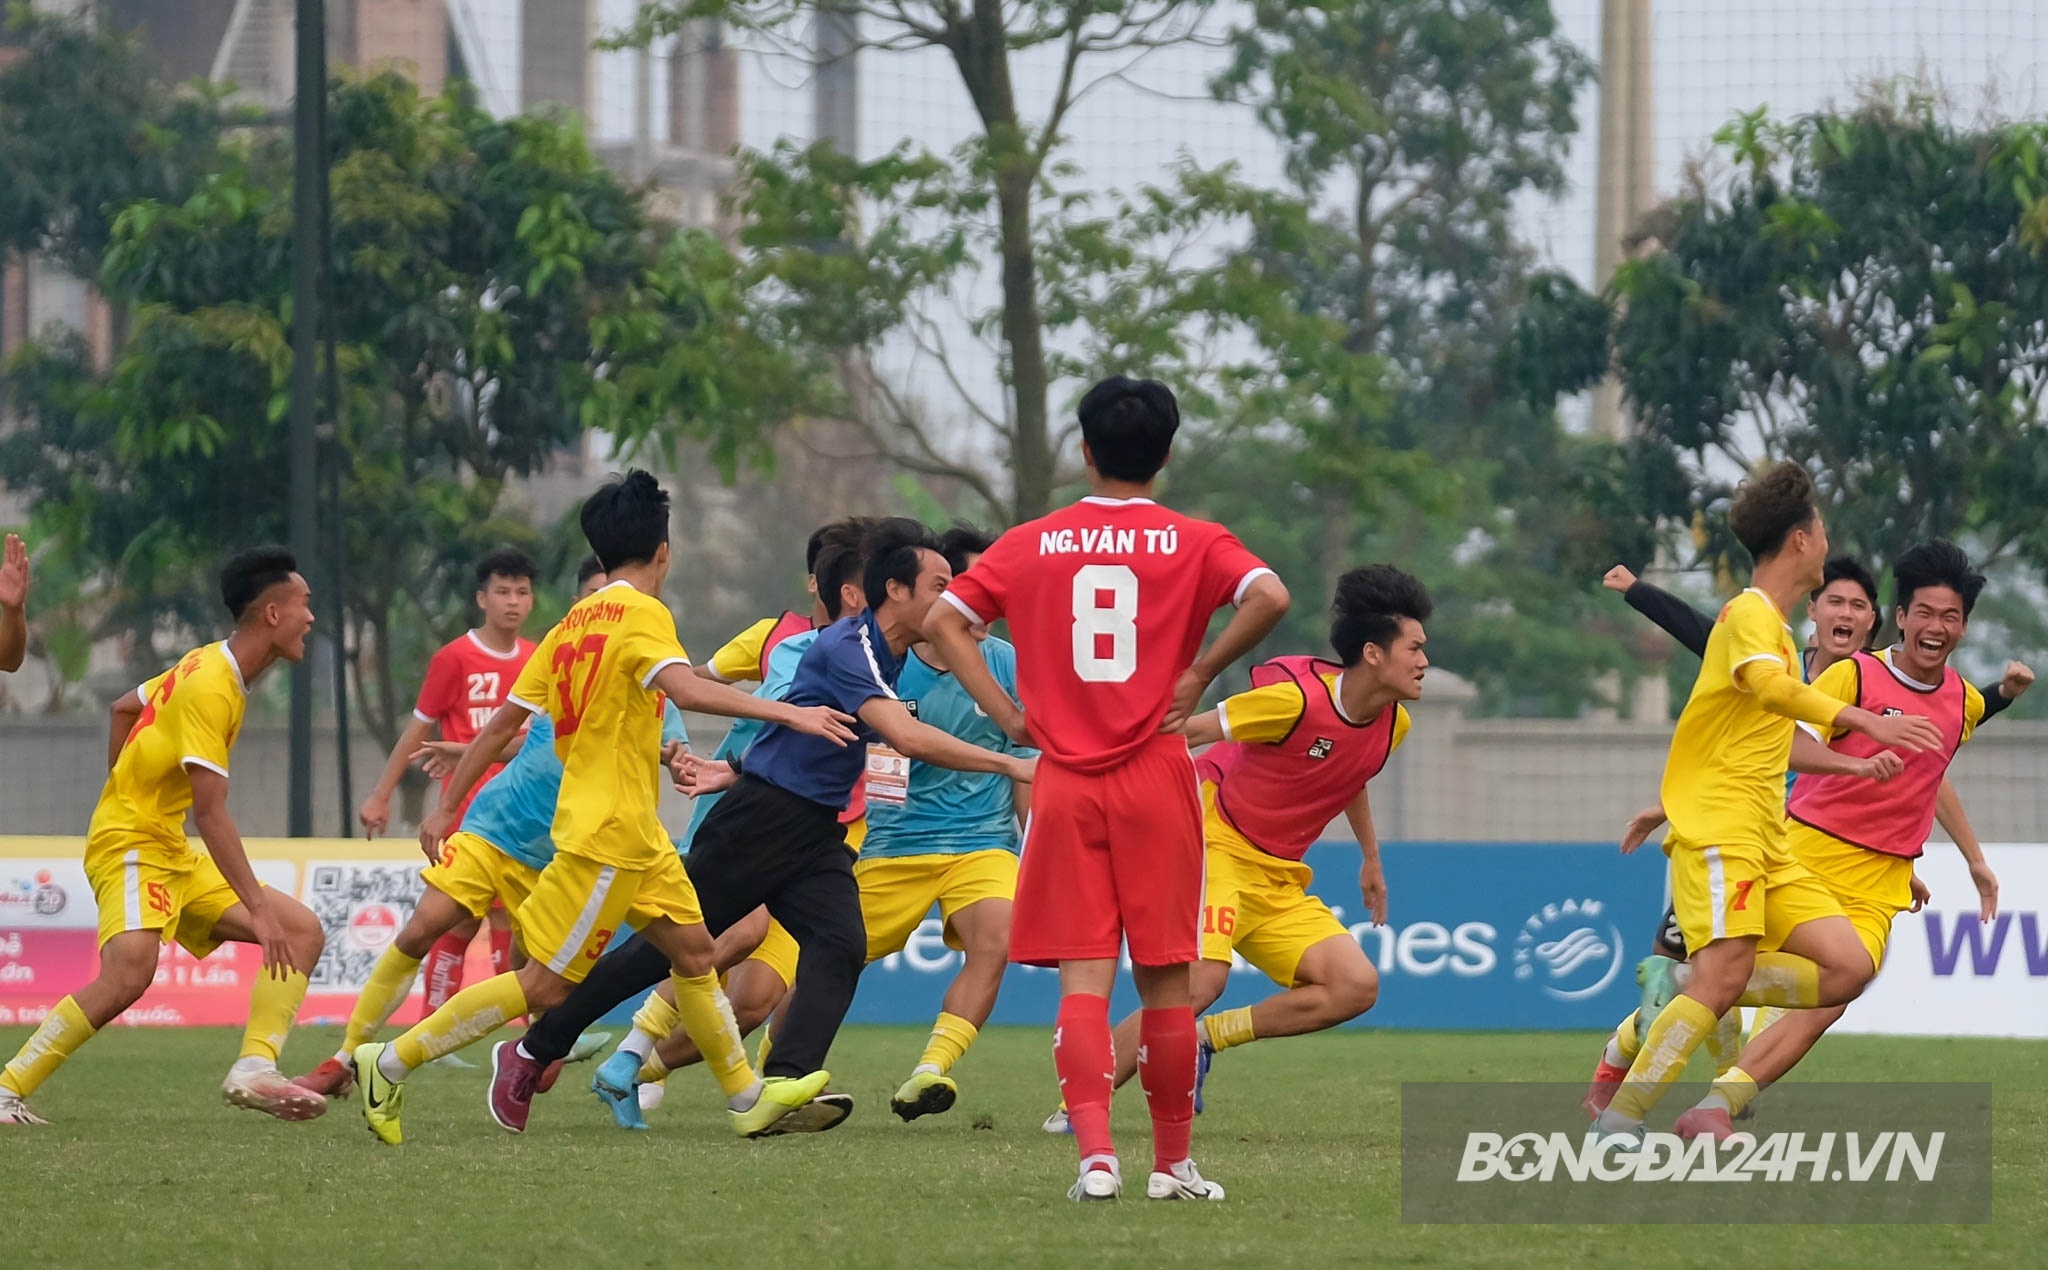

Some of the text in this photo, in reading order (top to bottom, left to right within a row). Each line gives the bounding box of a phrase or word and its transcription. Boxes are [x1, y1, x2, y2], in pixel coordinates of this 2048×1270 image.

[1039, 524, 1178, 556] NG.VĂN TÚ
[1072, 564, 1139, 682] 8
[467, 671, 500, 701] 27
[551, 633, 609, 740] 37
[1733, 880, 1754, 911] 7
[1203, 905, 1236, 937] 16
